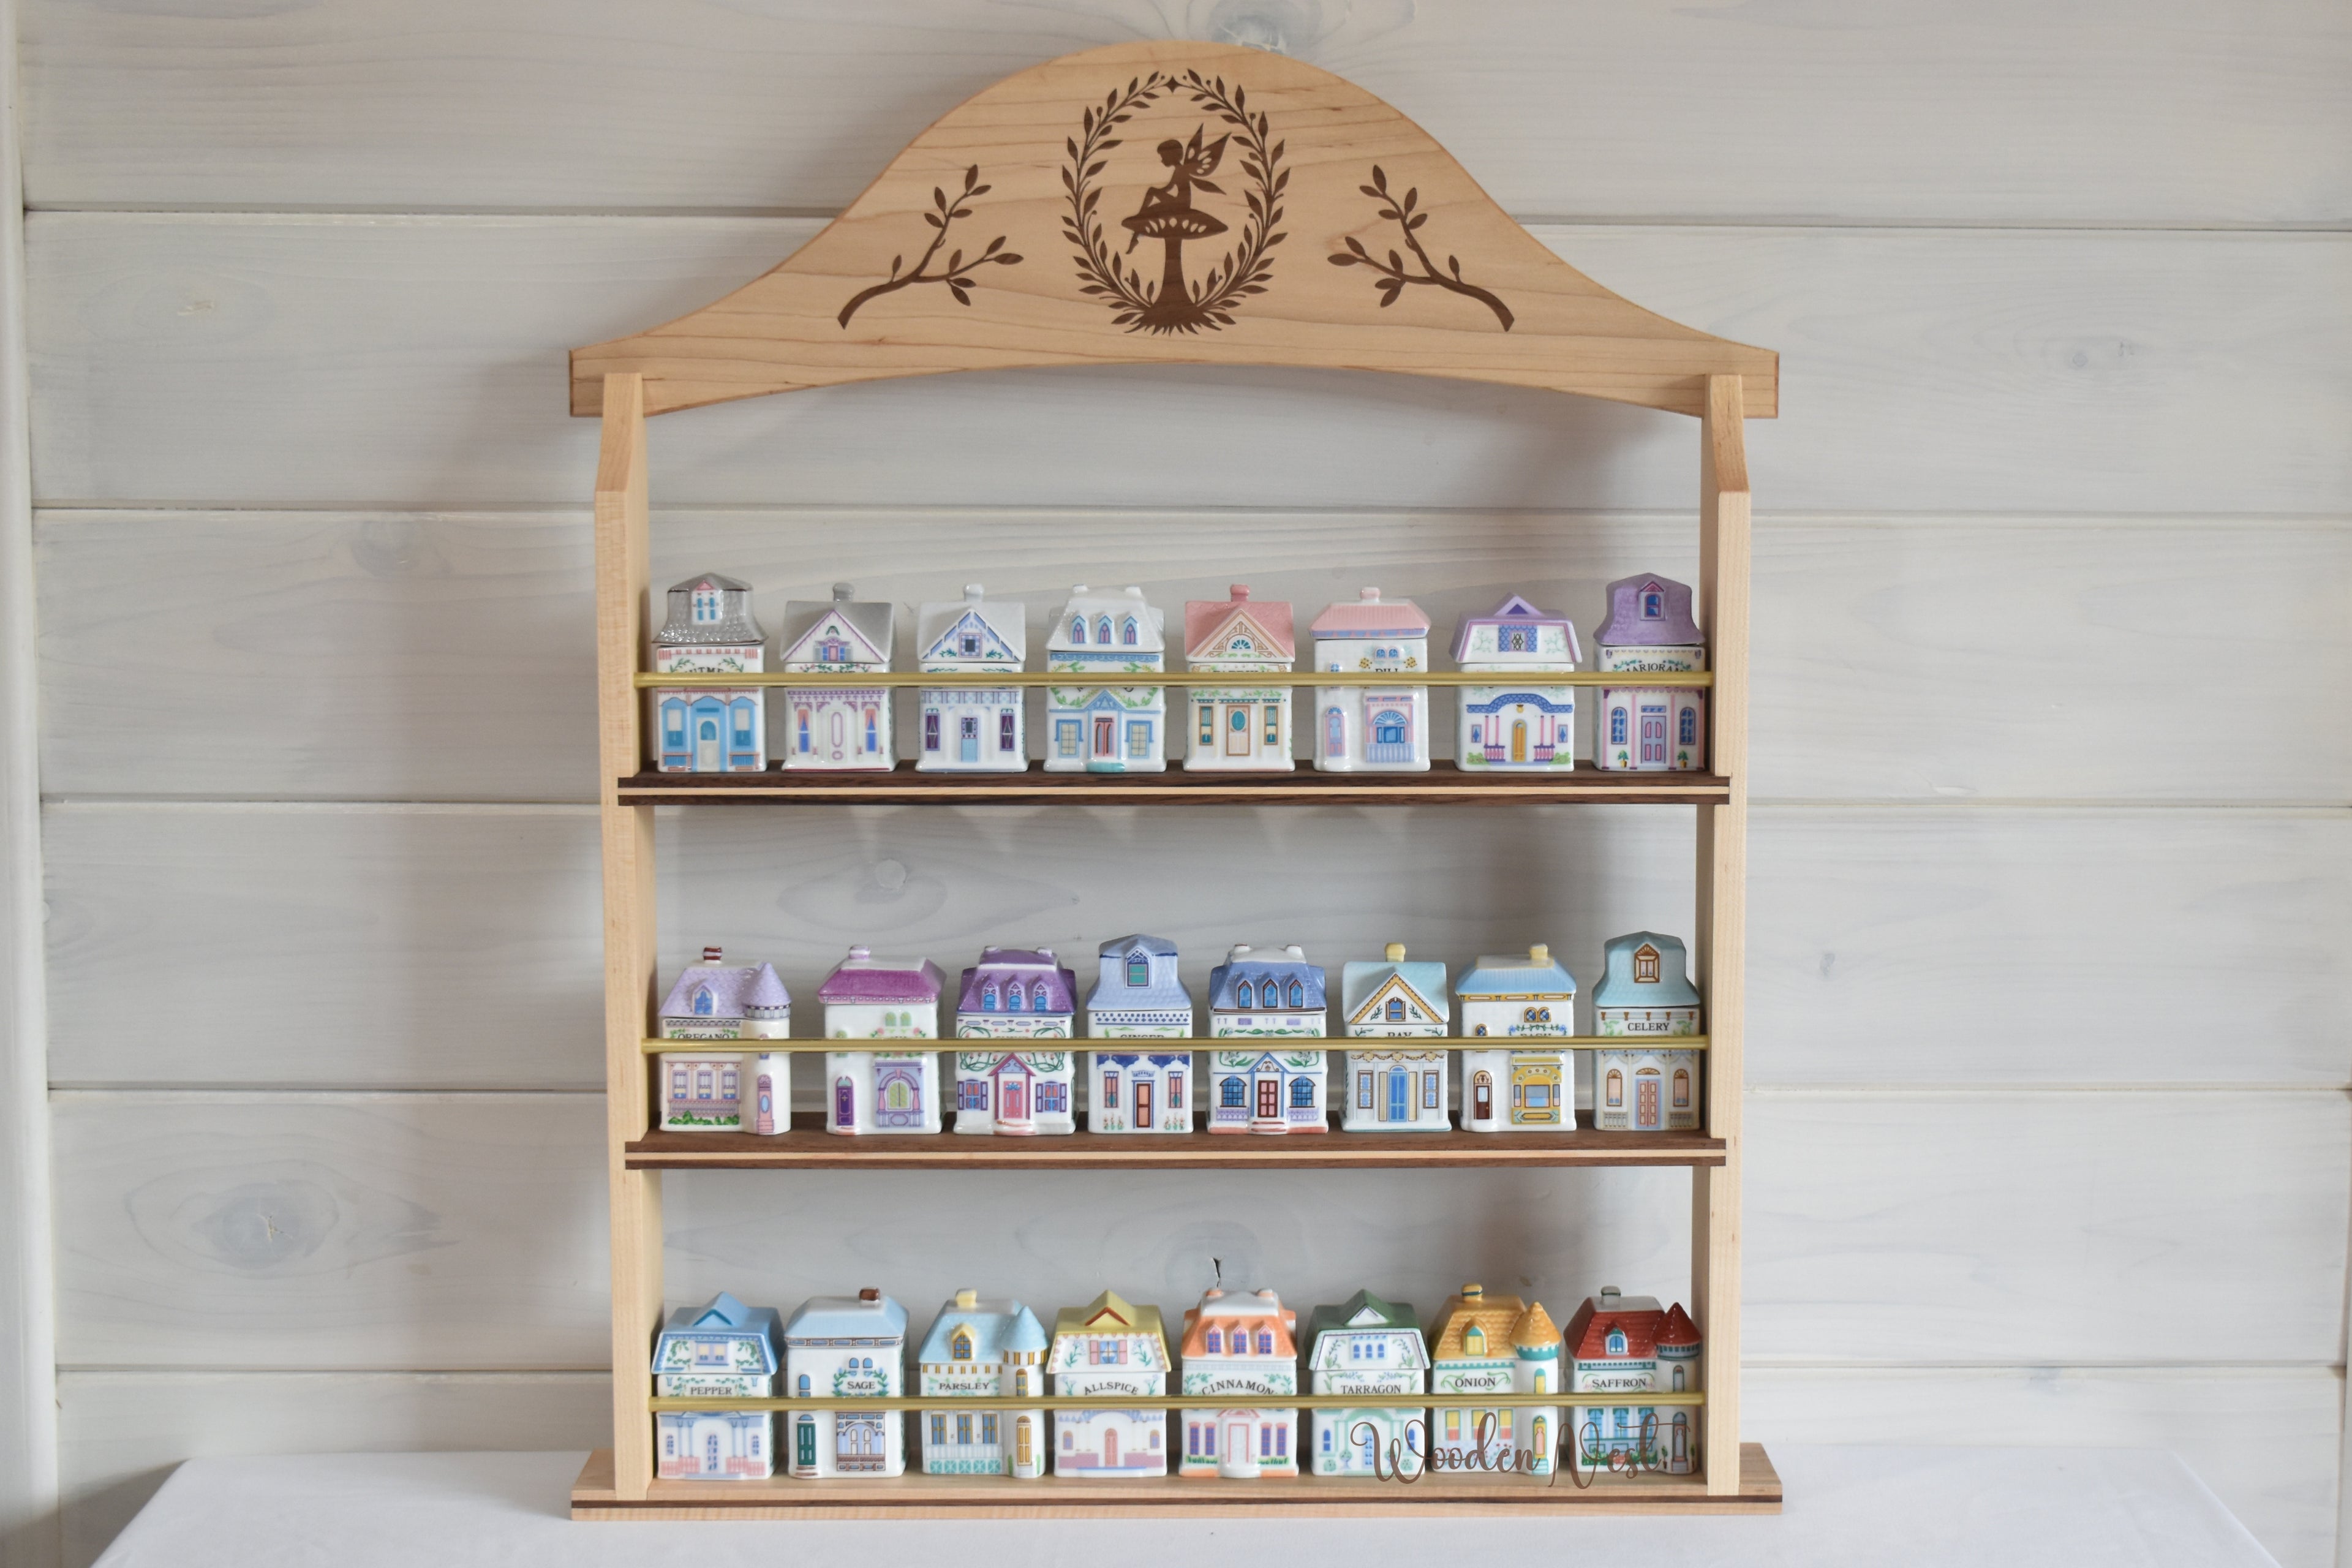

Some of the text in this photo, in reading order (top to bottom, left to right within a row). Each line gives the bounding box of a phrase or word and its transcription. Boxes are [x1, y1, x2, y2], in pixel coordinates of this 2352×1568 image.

[1627, 1022, 1670, 1031] CELERY
[1455, 1378, 1496, 1387] ONION
[1592, 1378, 1647, 1387] SAFFRON
[690, 1386, 732, 1395] PEPPER
[1084, 1382, 1139, 1395] ALLSPICE
[1341, 1384, 1401, 1394] TARRAGON
